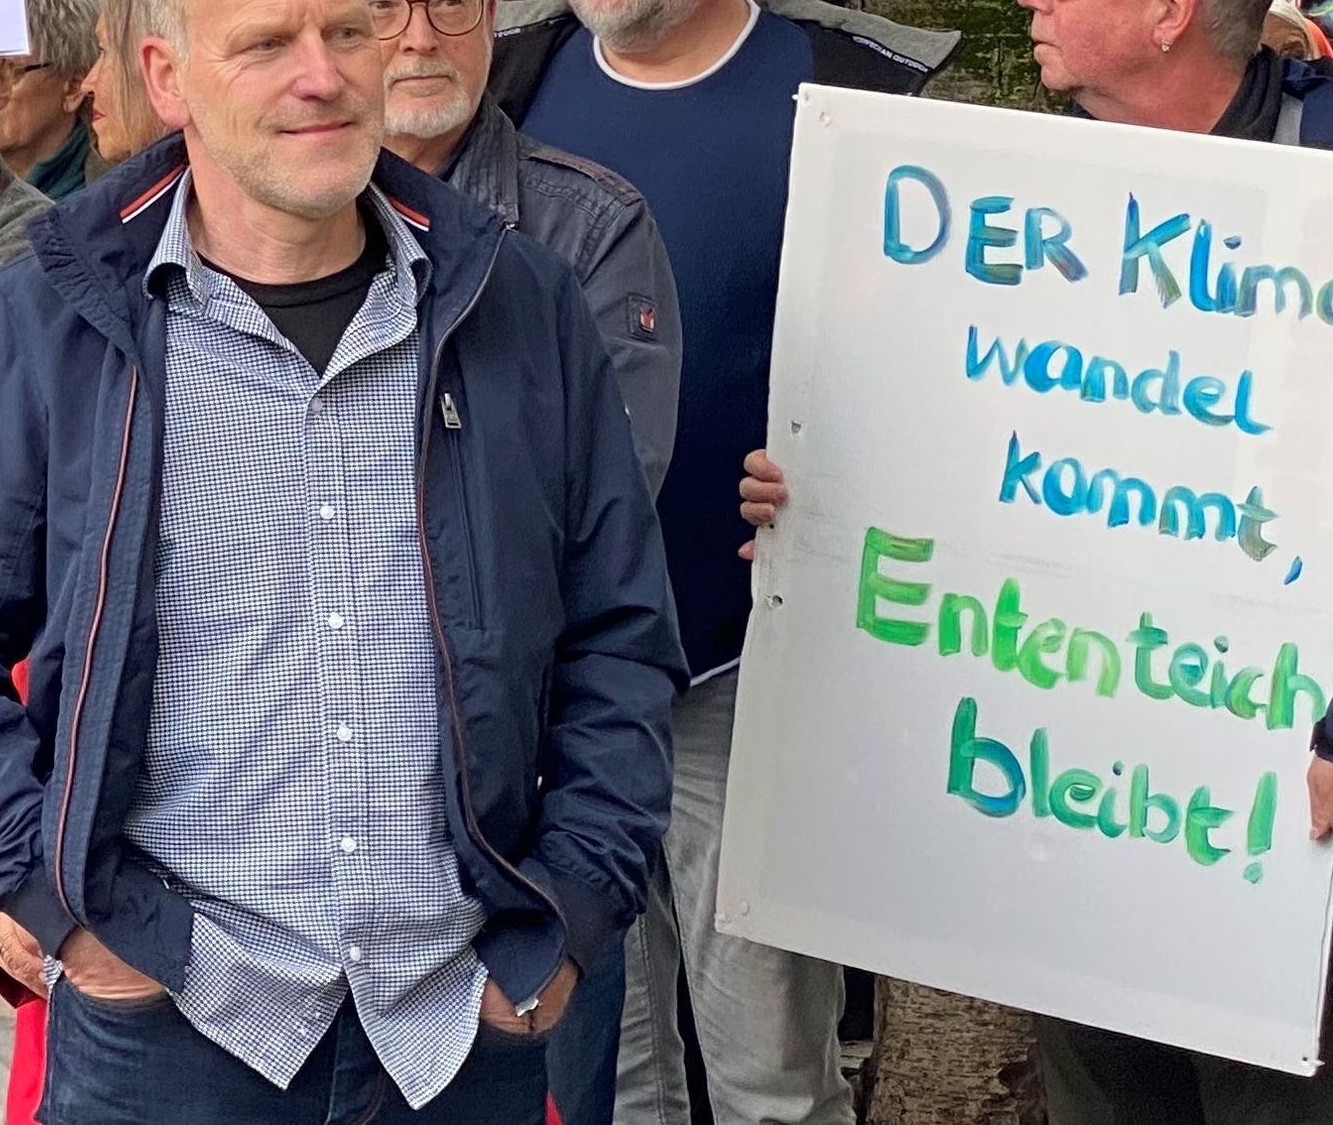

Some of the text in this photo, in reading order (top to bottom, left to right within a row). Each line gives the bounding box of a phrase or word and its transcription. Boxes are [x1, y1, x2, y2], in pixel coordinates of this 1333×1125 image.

[883, 164, 1089, 286] DER
[965, 325, 1274, 436] wandel
[998, 429, 1304, 585] kommt,
[856, 526, 1327, 731] Ententeich
[946, 696, 1278, 885] bleibt!
